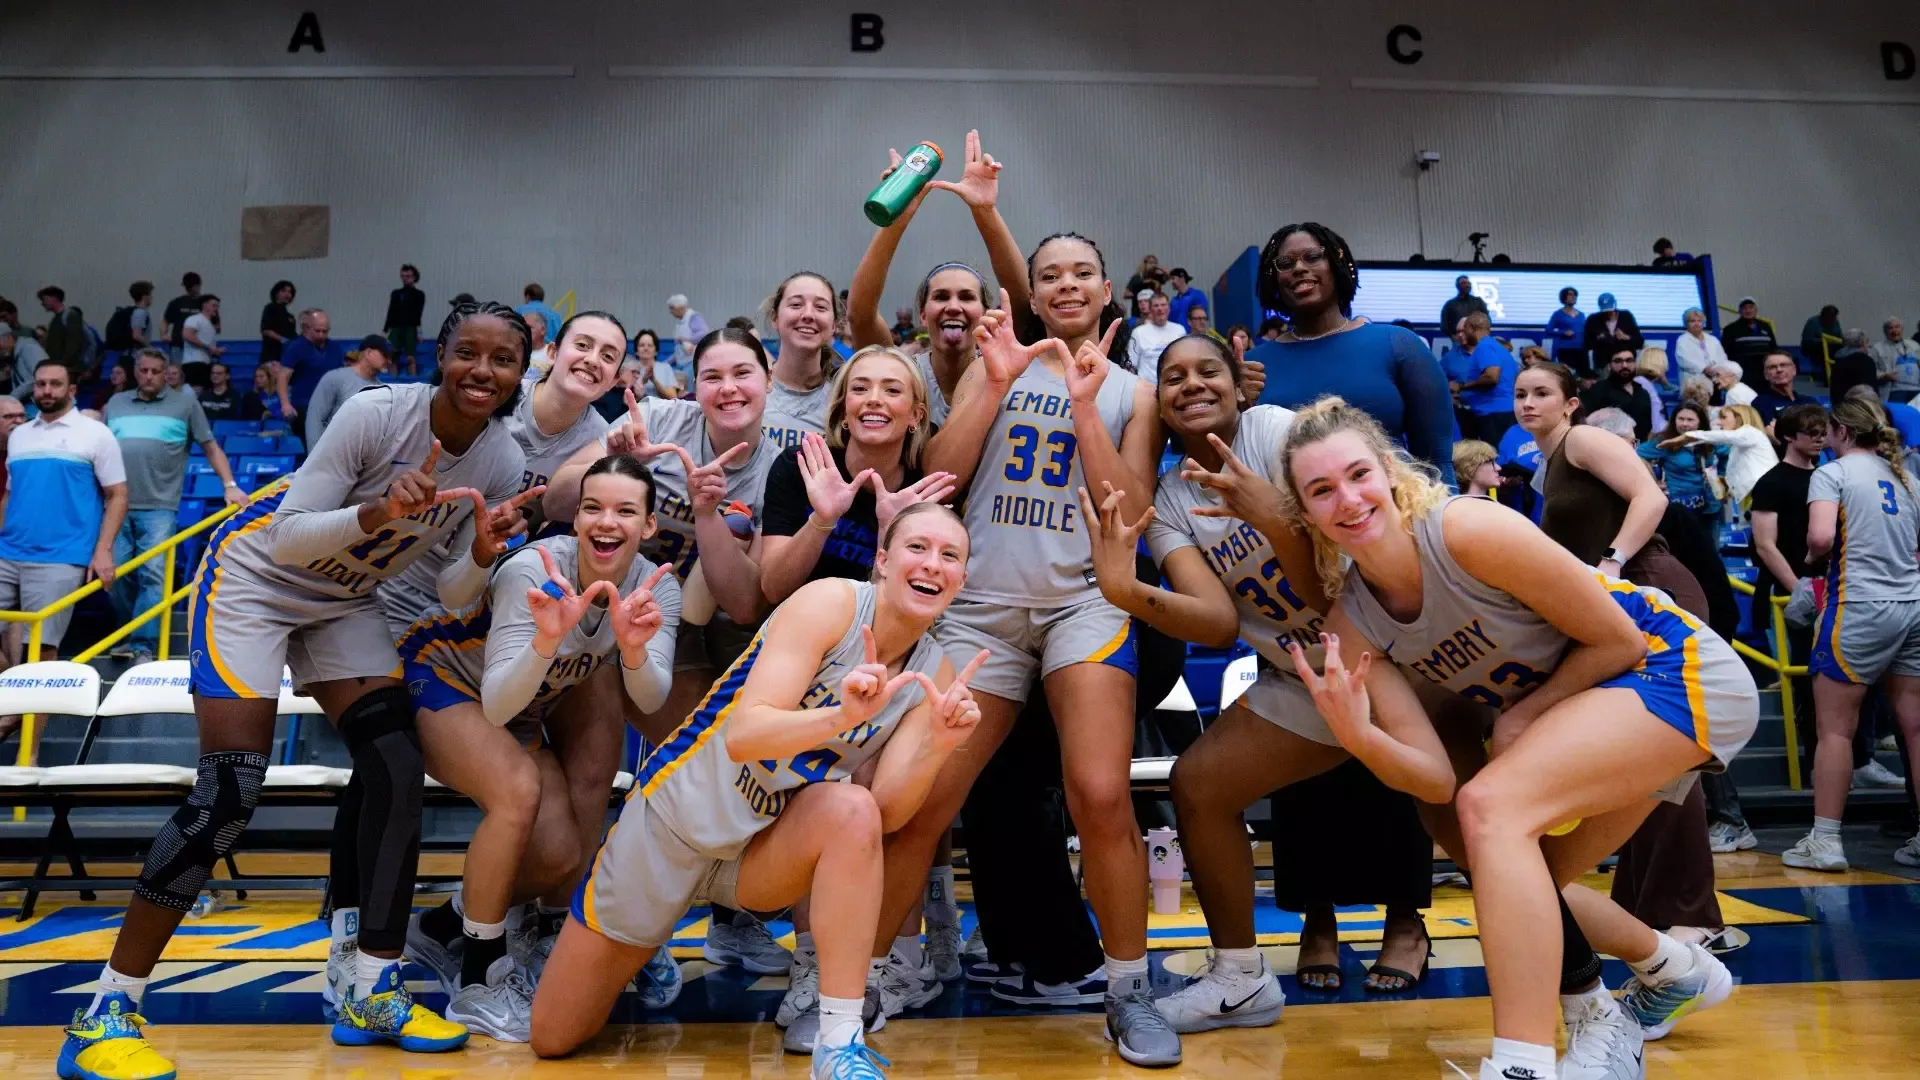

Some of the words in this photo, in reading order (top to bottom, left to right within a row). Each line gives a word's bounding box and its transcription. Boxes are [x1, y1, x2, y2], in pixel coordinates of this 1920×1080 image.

[287, 12, 325, 53] A
[850, 13, 884, 53] B
[1386, 24, 1424, 65] C
[1880, 41, 1916, 80] D
[1004, 423, 1078, 488] 33
[991, 494, 1077, 534] RIDDLE
[1877, 479, 1899, 516] 3
[348, 528, 420, 571] 11
[1409, 619, 1498, 684] EMBRY
